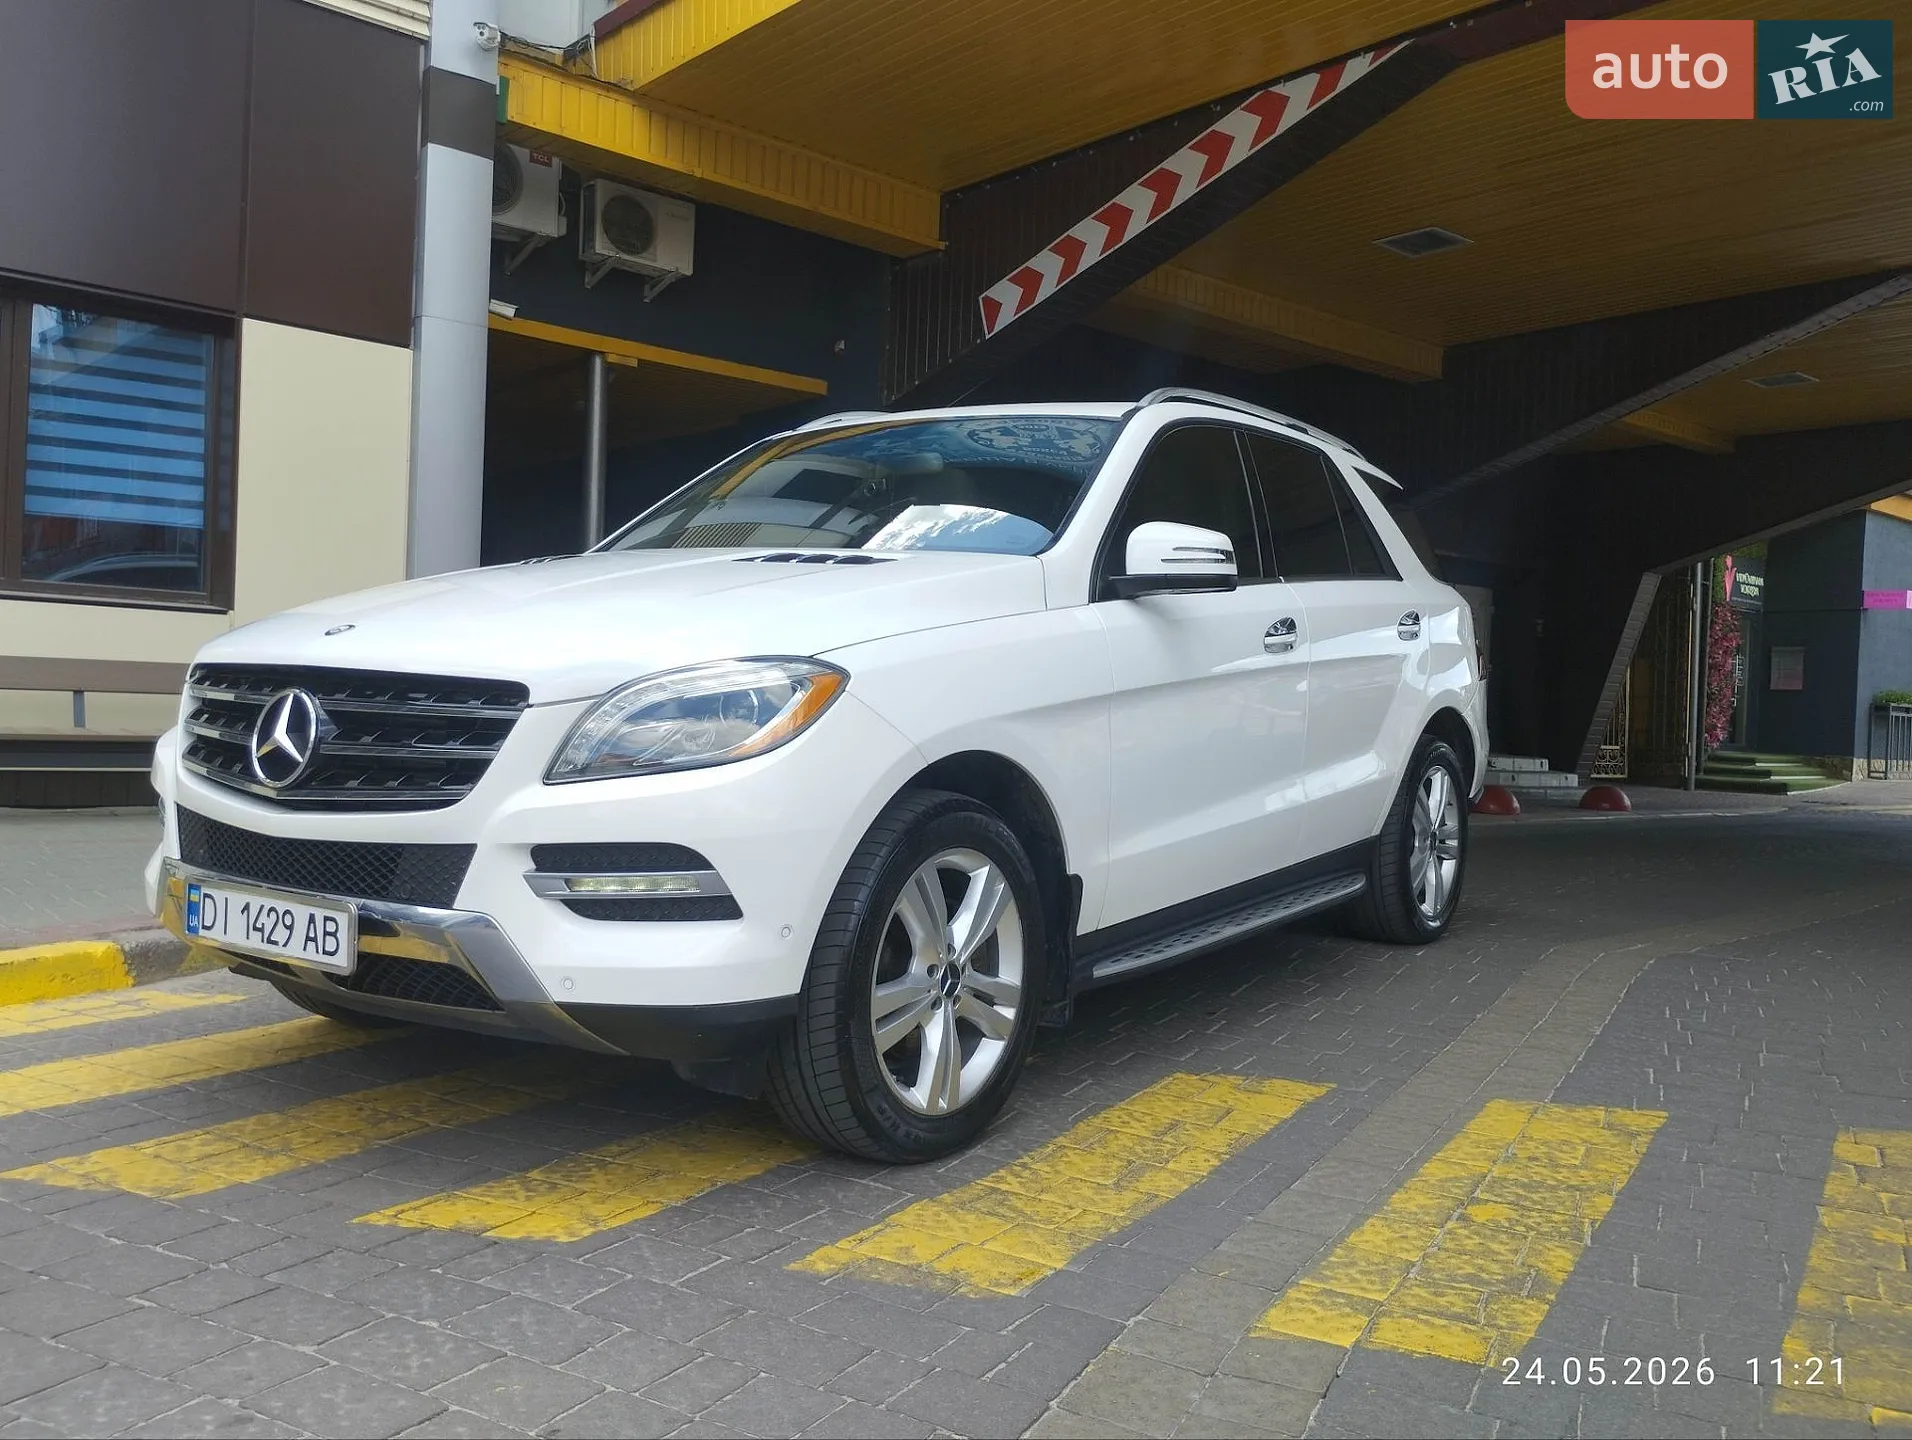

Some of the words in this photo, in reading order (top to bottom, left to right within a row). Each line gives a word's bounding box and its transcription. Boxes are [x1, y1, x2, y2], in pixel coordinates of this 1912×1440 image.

[531, 152, 550, 163] TCL
[189, 914, 199, 928] UA
[201, 892, 228, 936] DI
[240, 901, 295, 948] 1429
[302, 912, 340, 957] AB
